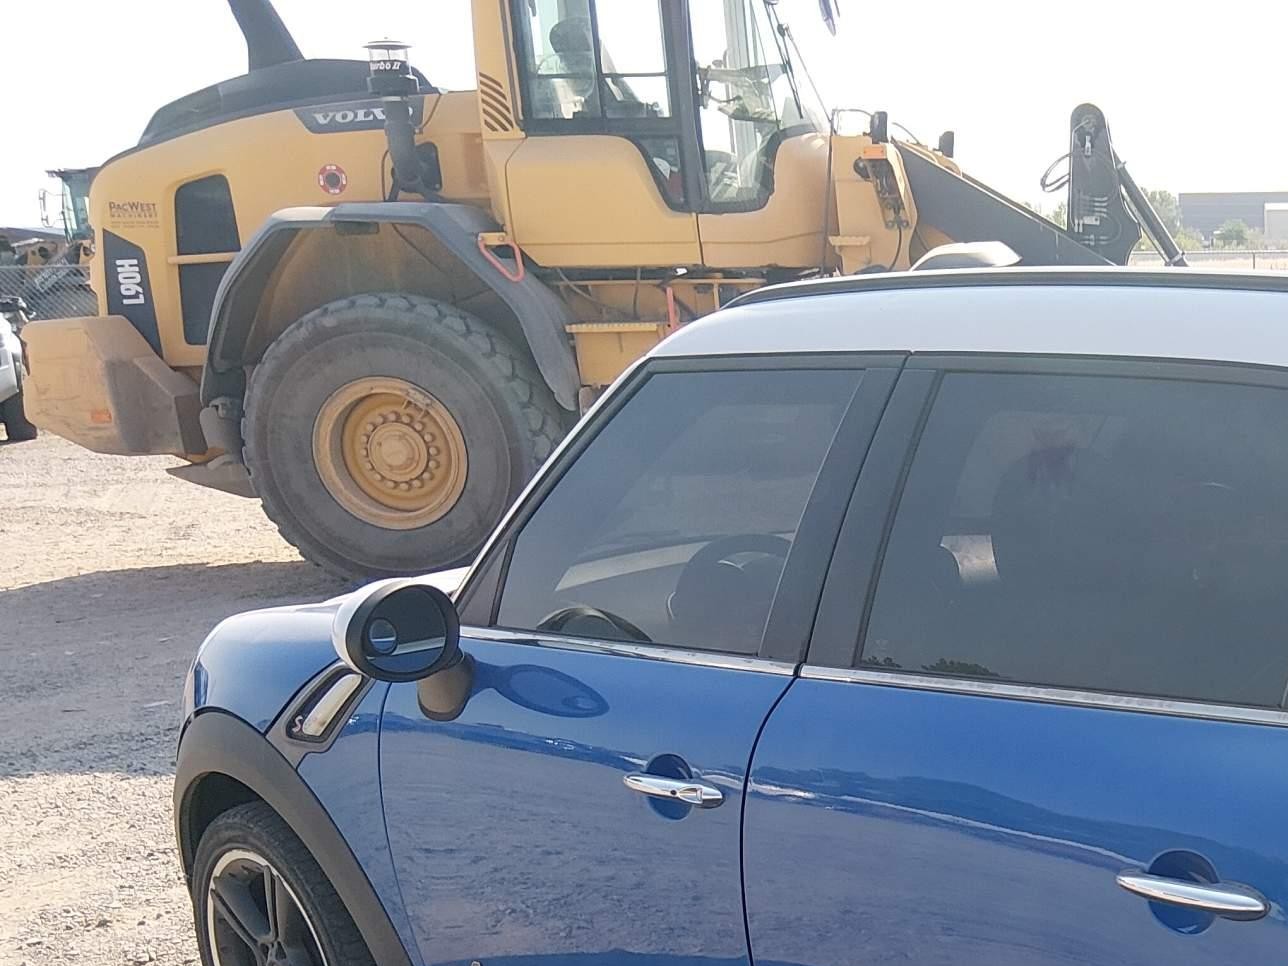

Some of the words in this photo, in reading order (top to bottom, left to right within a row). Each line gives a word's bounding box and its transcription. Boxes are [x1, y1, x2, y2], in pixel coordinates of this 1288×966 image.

[312, 107, 414, 125] VOLV
[115, 259, 145, 305] L90H
[291, 715, 304, 733] S
